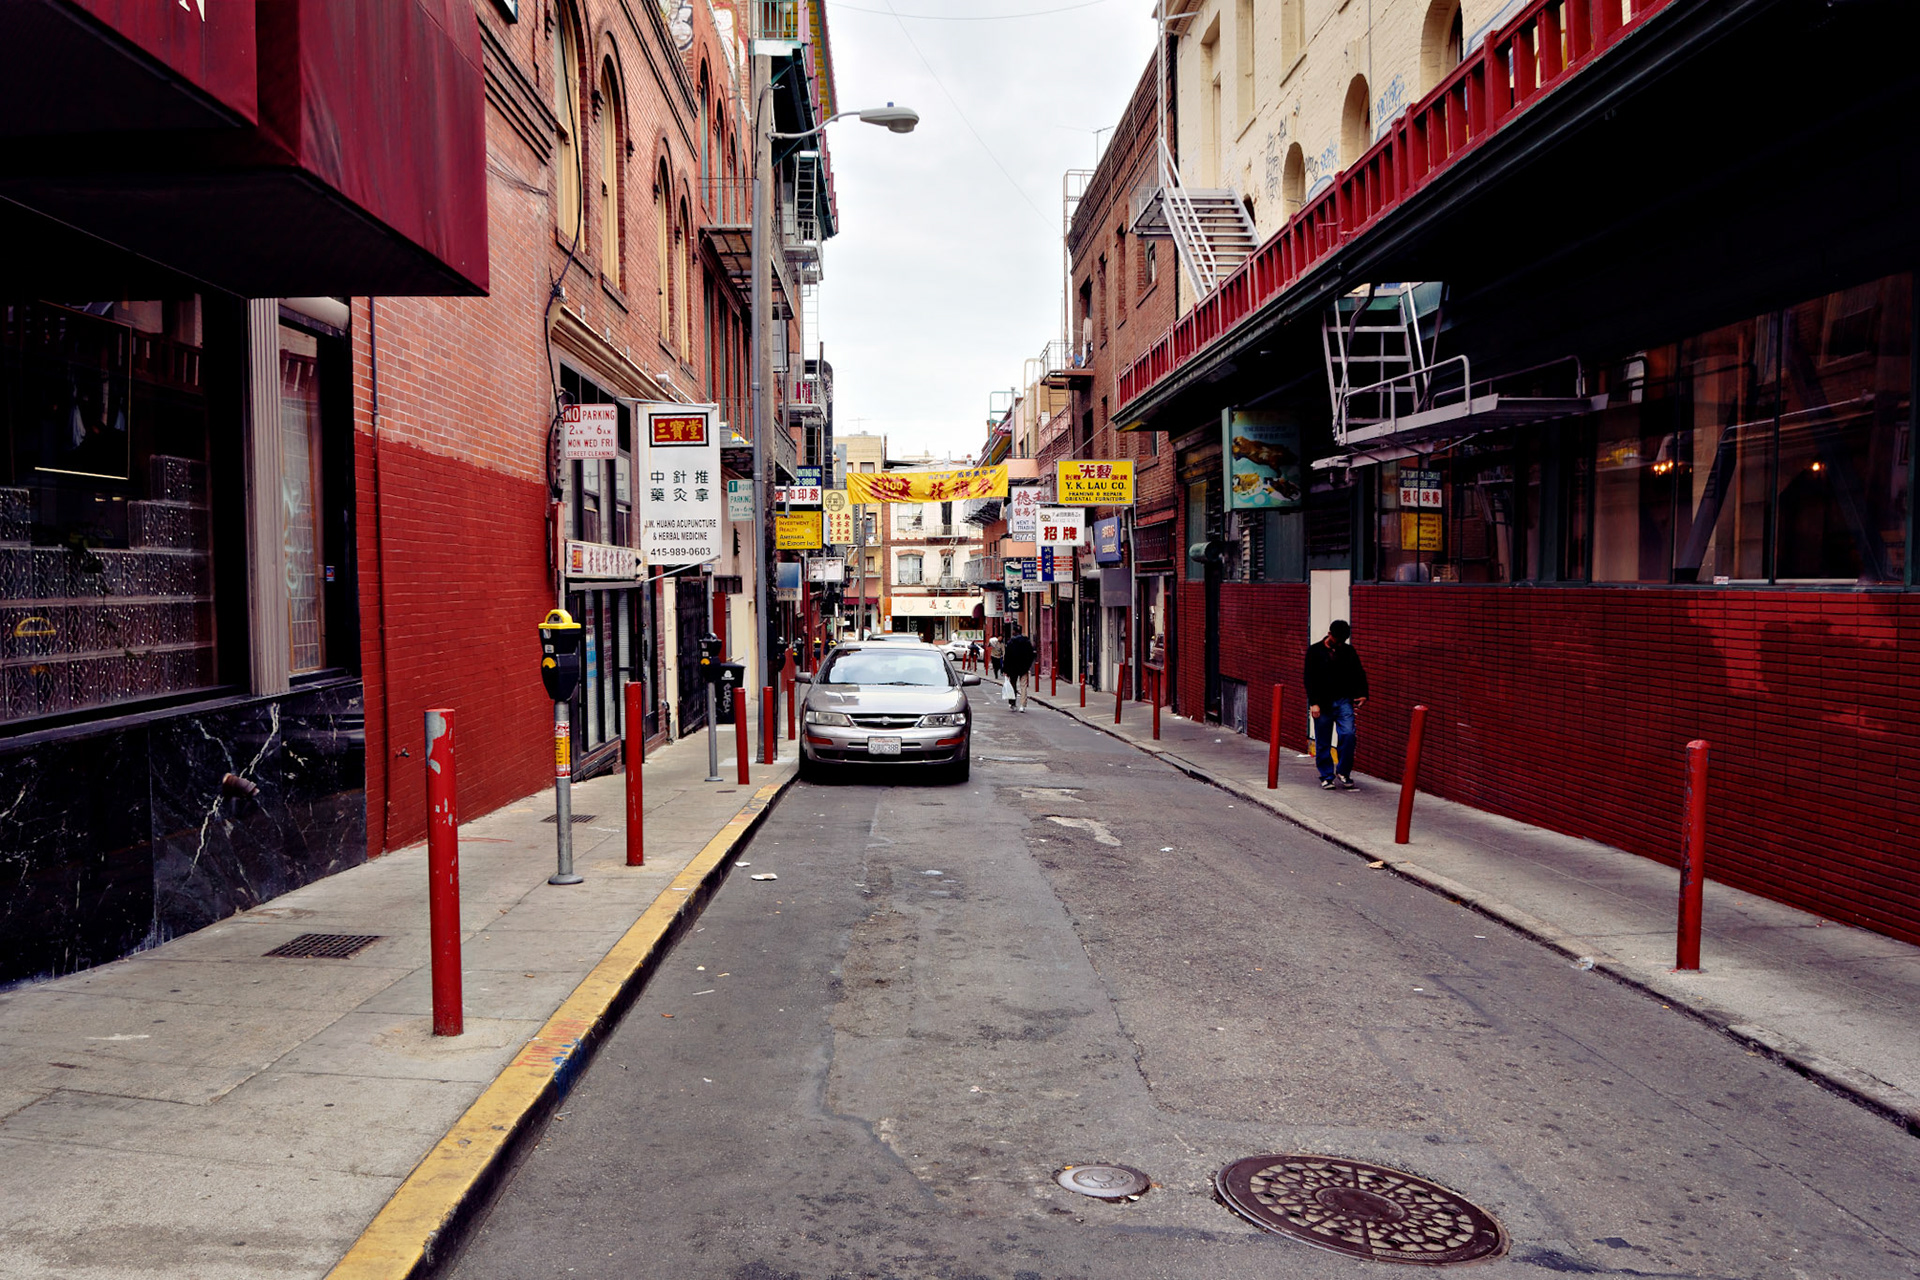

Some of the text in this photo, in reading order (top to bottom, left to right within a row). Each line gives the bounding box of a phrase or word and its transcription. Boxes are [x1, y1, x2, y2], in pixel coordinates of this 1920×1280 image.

[565, 407, 614, 421] NO PARKING
[655, 419, 702, 440] 三寶堂
[567, 439, 613, 447] MON WED FRI
[877, 480, 904, 491] $100
[657, 520, 675, 528] HUANG
[677, 519, 716, 528] ACUPUNCTURE
[653, 532, 707, 540] & HERBAL MEDICINE
[1044, 526, 1077, 541] 招牌
[650, 547, 711, 556] 415-989-0603
